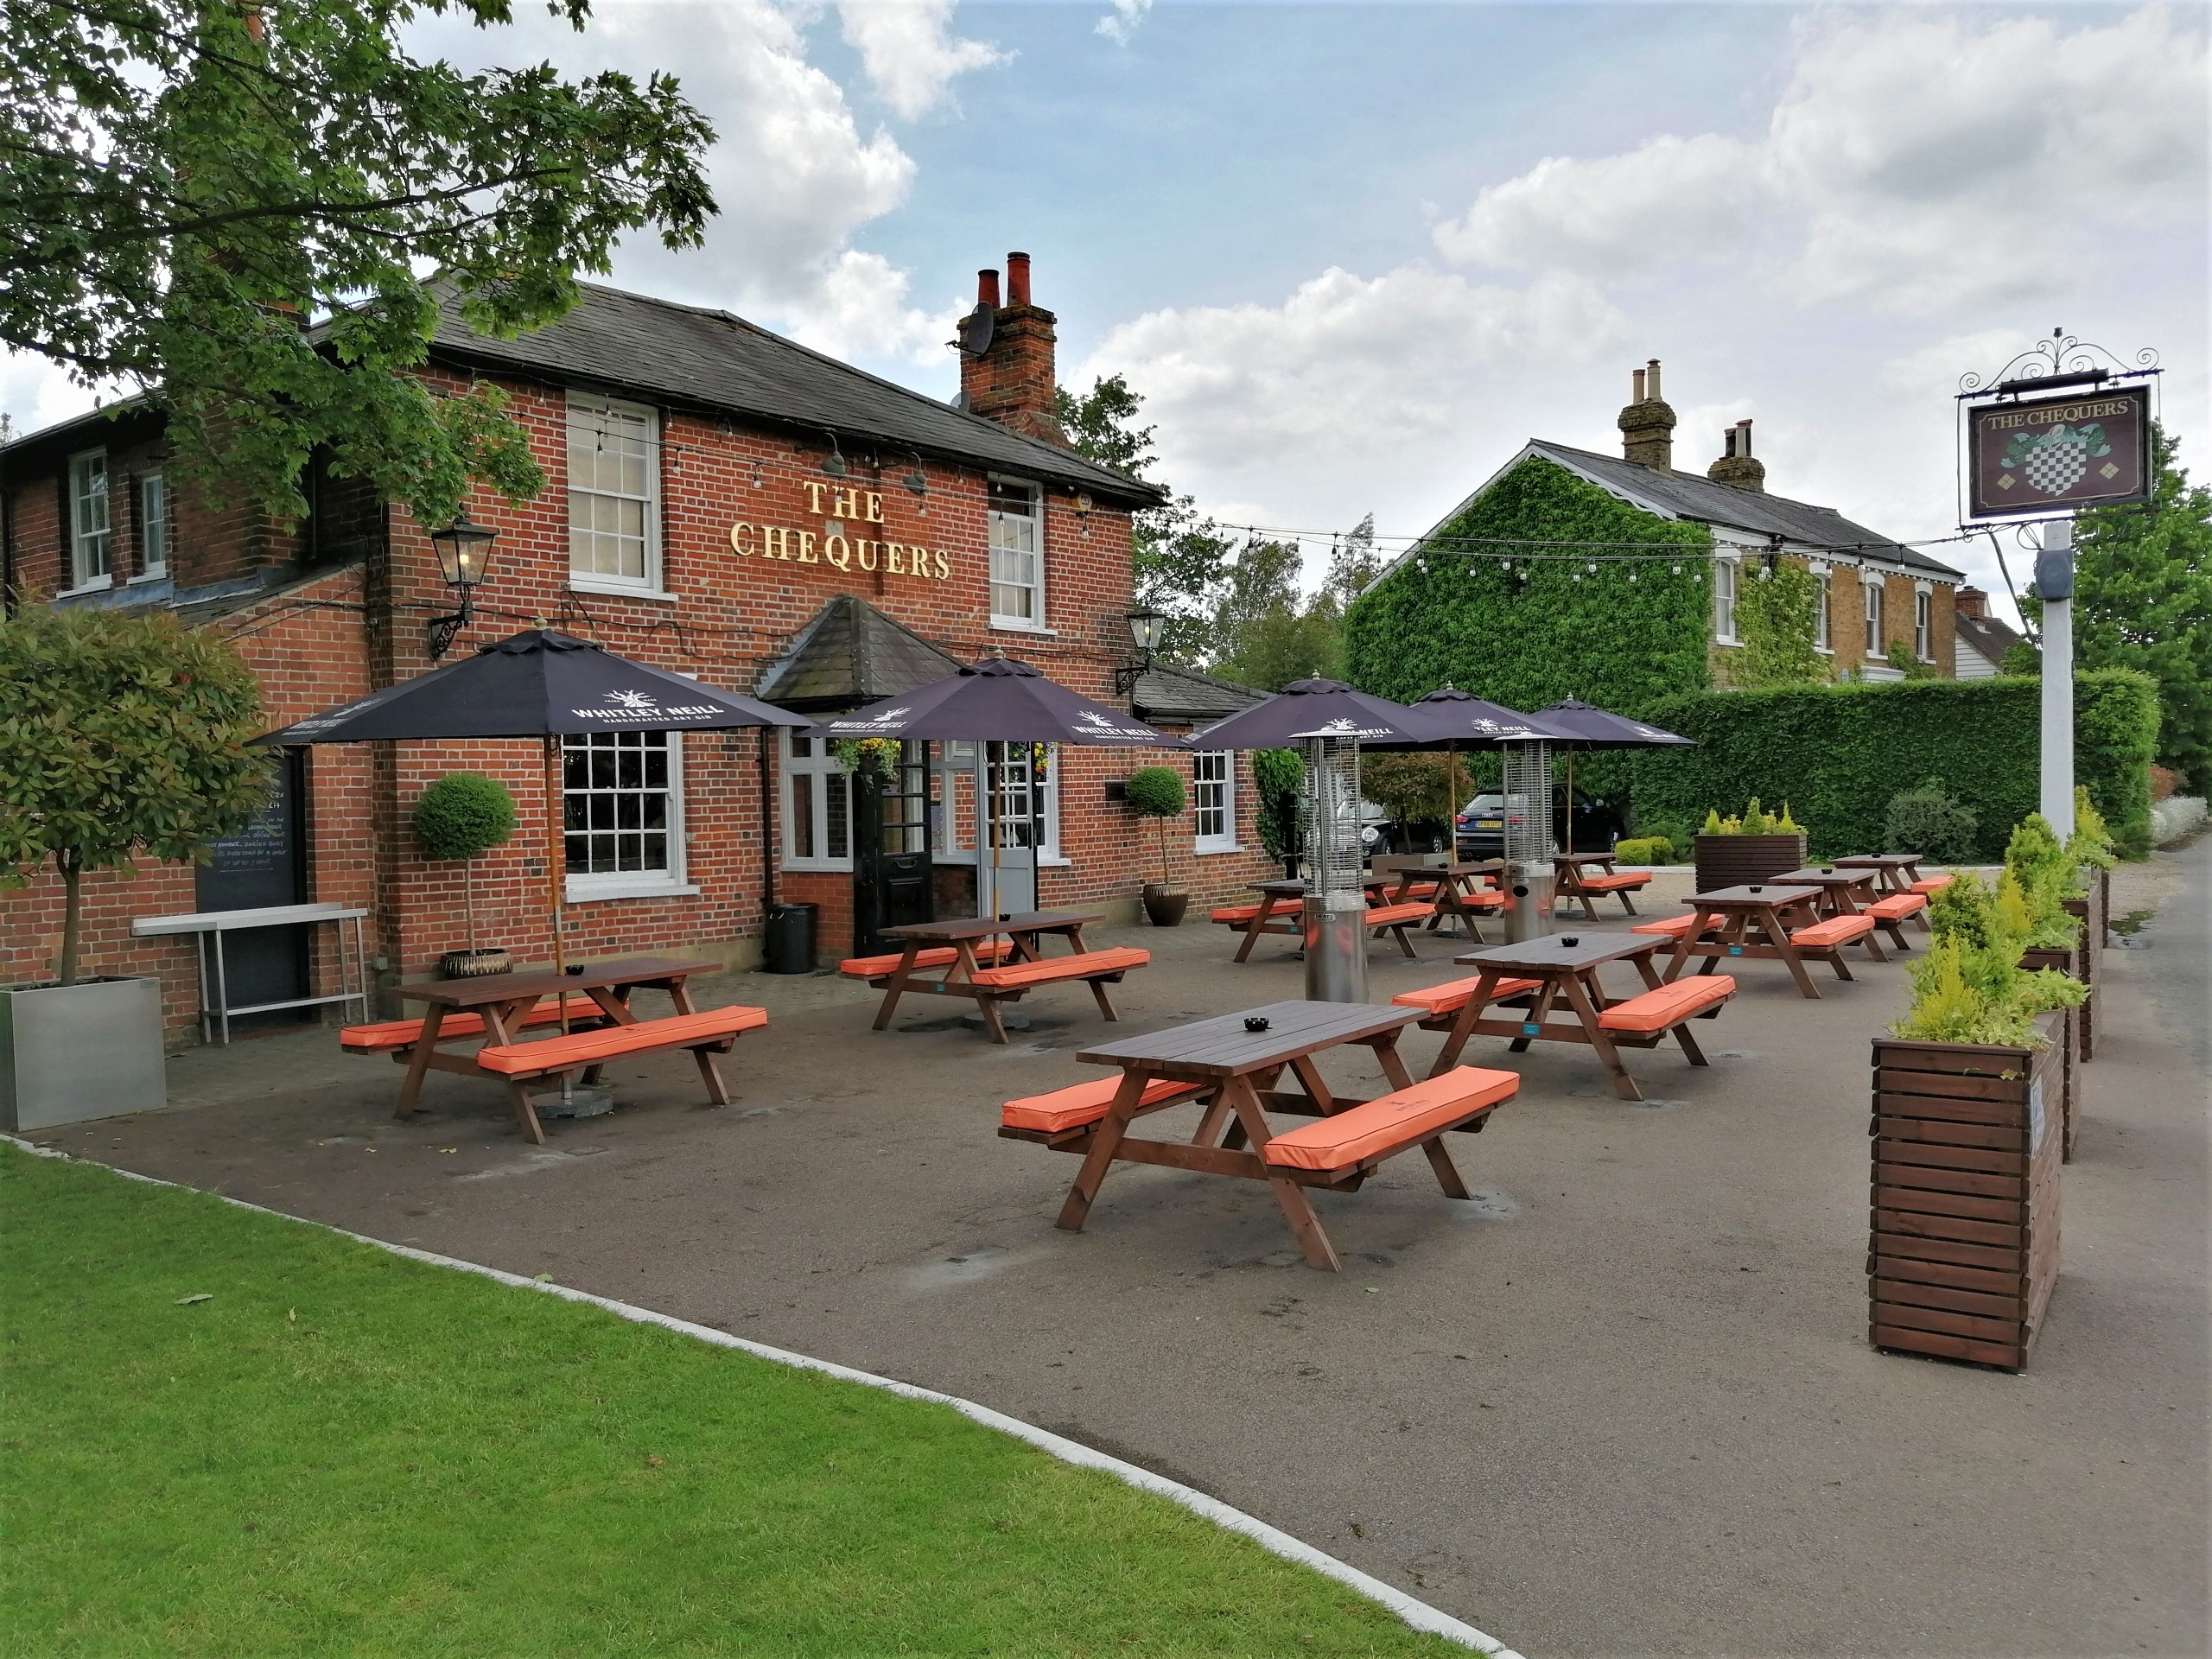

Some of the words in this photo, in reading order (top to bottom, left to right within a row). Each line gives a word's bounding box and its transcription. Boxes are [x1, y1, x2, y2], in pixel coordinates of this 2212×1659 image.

[1988, 414, 2024, 430] THE
[2027, 400, 2129, 425] CHEQUERS
[804, 480, 885, 524] THE
[730, 522, 950, 580] CHEQUERS
[571, 709, 662, 717] WHITLEY
[666, 705, 725, 715] NEILL
[1071, 726, 1124, 735] WHITLEY
